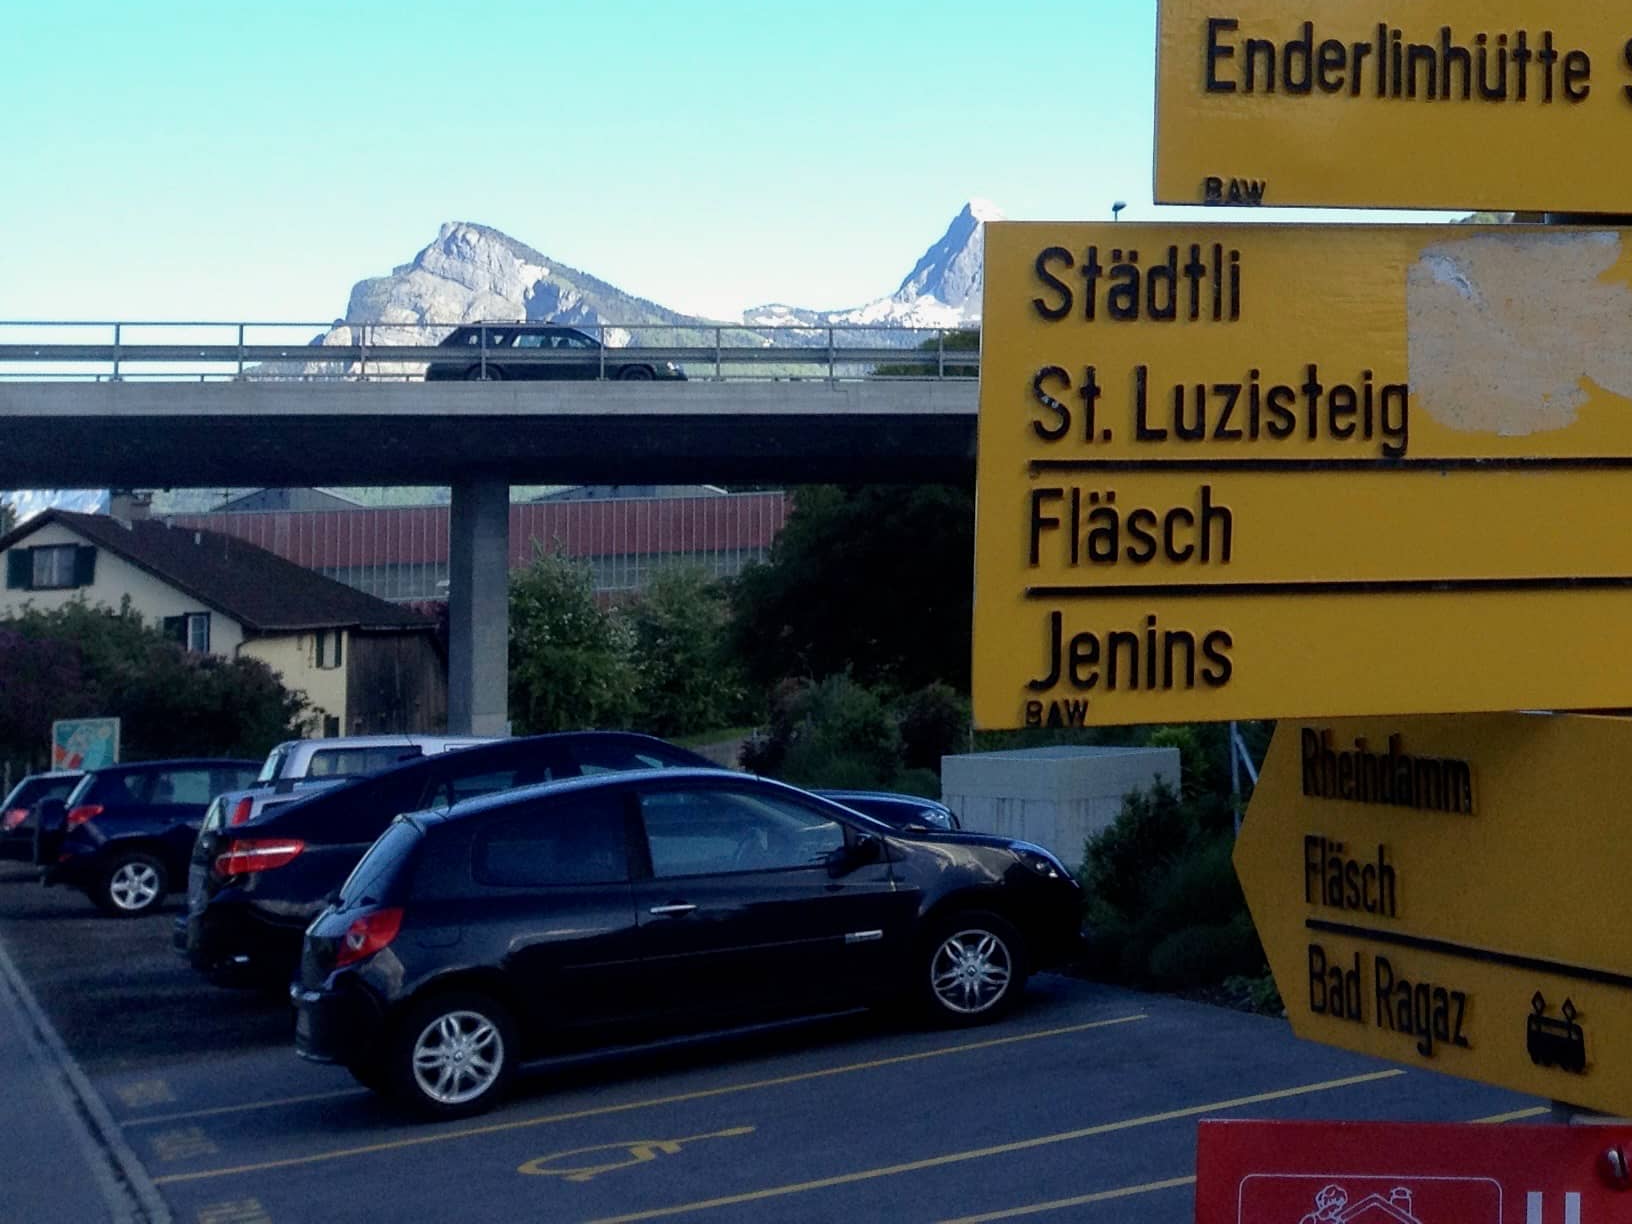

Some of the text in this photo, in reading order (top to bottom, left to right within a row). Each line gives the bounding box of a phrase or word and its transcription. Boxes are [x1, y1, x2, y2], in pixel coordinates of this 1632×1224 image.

[1205, 17, 1592, 105] Enderlinhütte
[1203, 176, 1267, 206] BAW
[1032, 242, 1242, 323] Städtli
[1032, 364, 1112, 443] St.
[1136, 363, 1410, 459] Luzisteig
[1028, 485, 1234, 568] Fläsch
[1026, 610, 1235, 691] Jenins
[1026, 699, 1089, 729] BAW
[1301, 727, 1474, 816] Rheindamm
[1303, 835, 1398, 918] Fläsch
[1308, 943, 1363, 1024] Bad
[1374, 957, 1471, 1058] Ragaz
